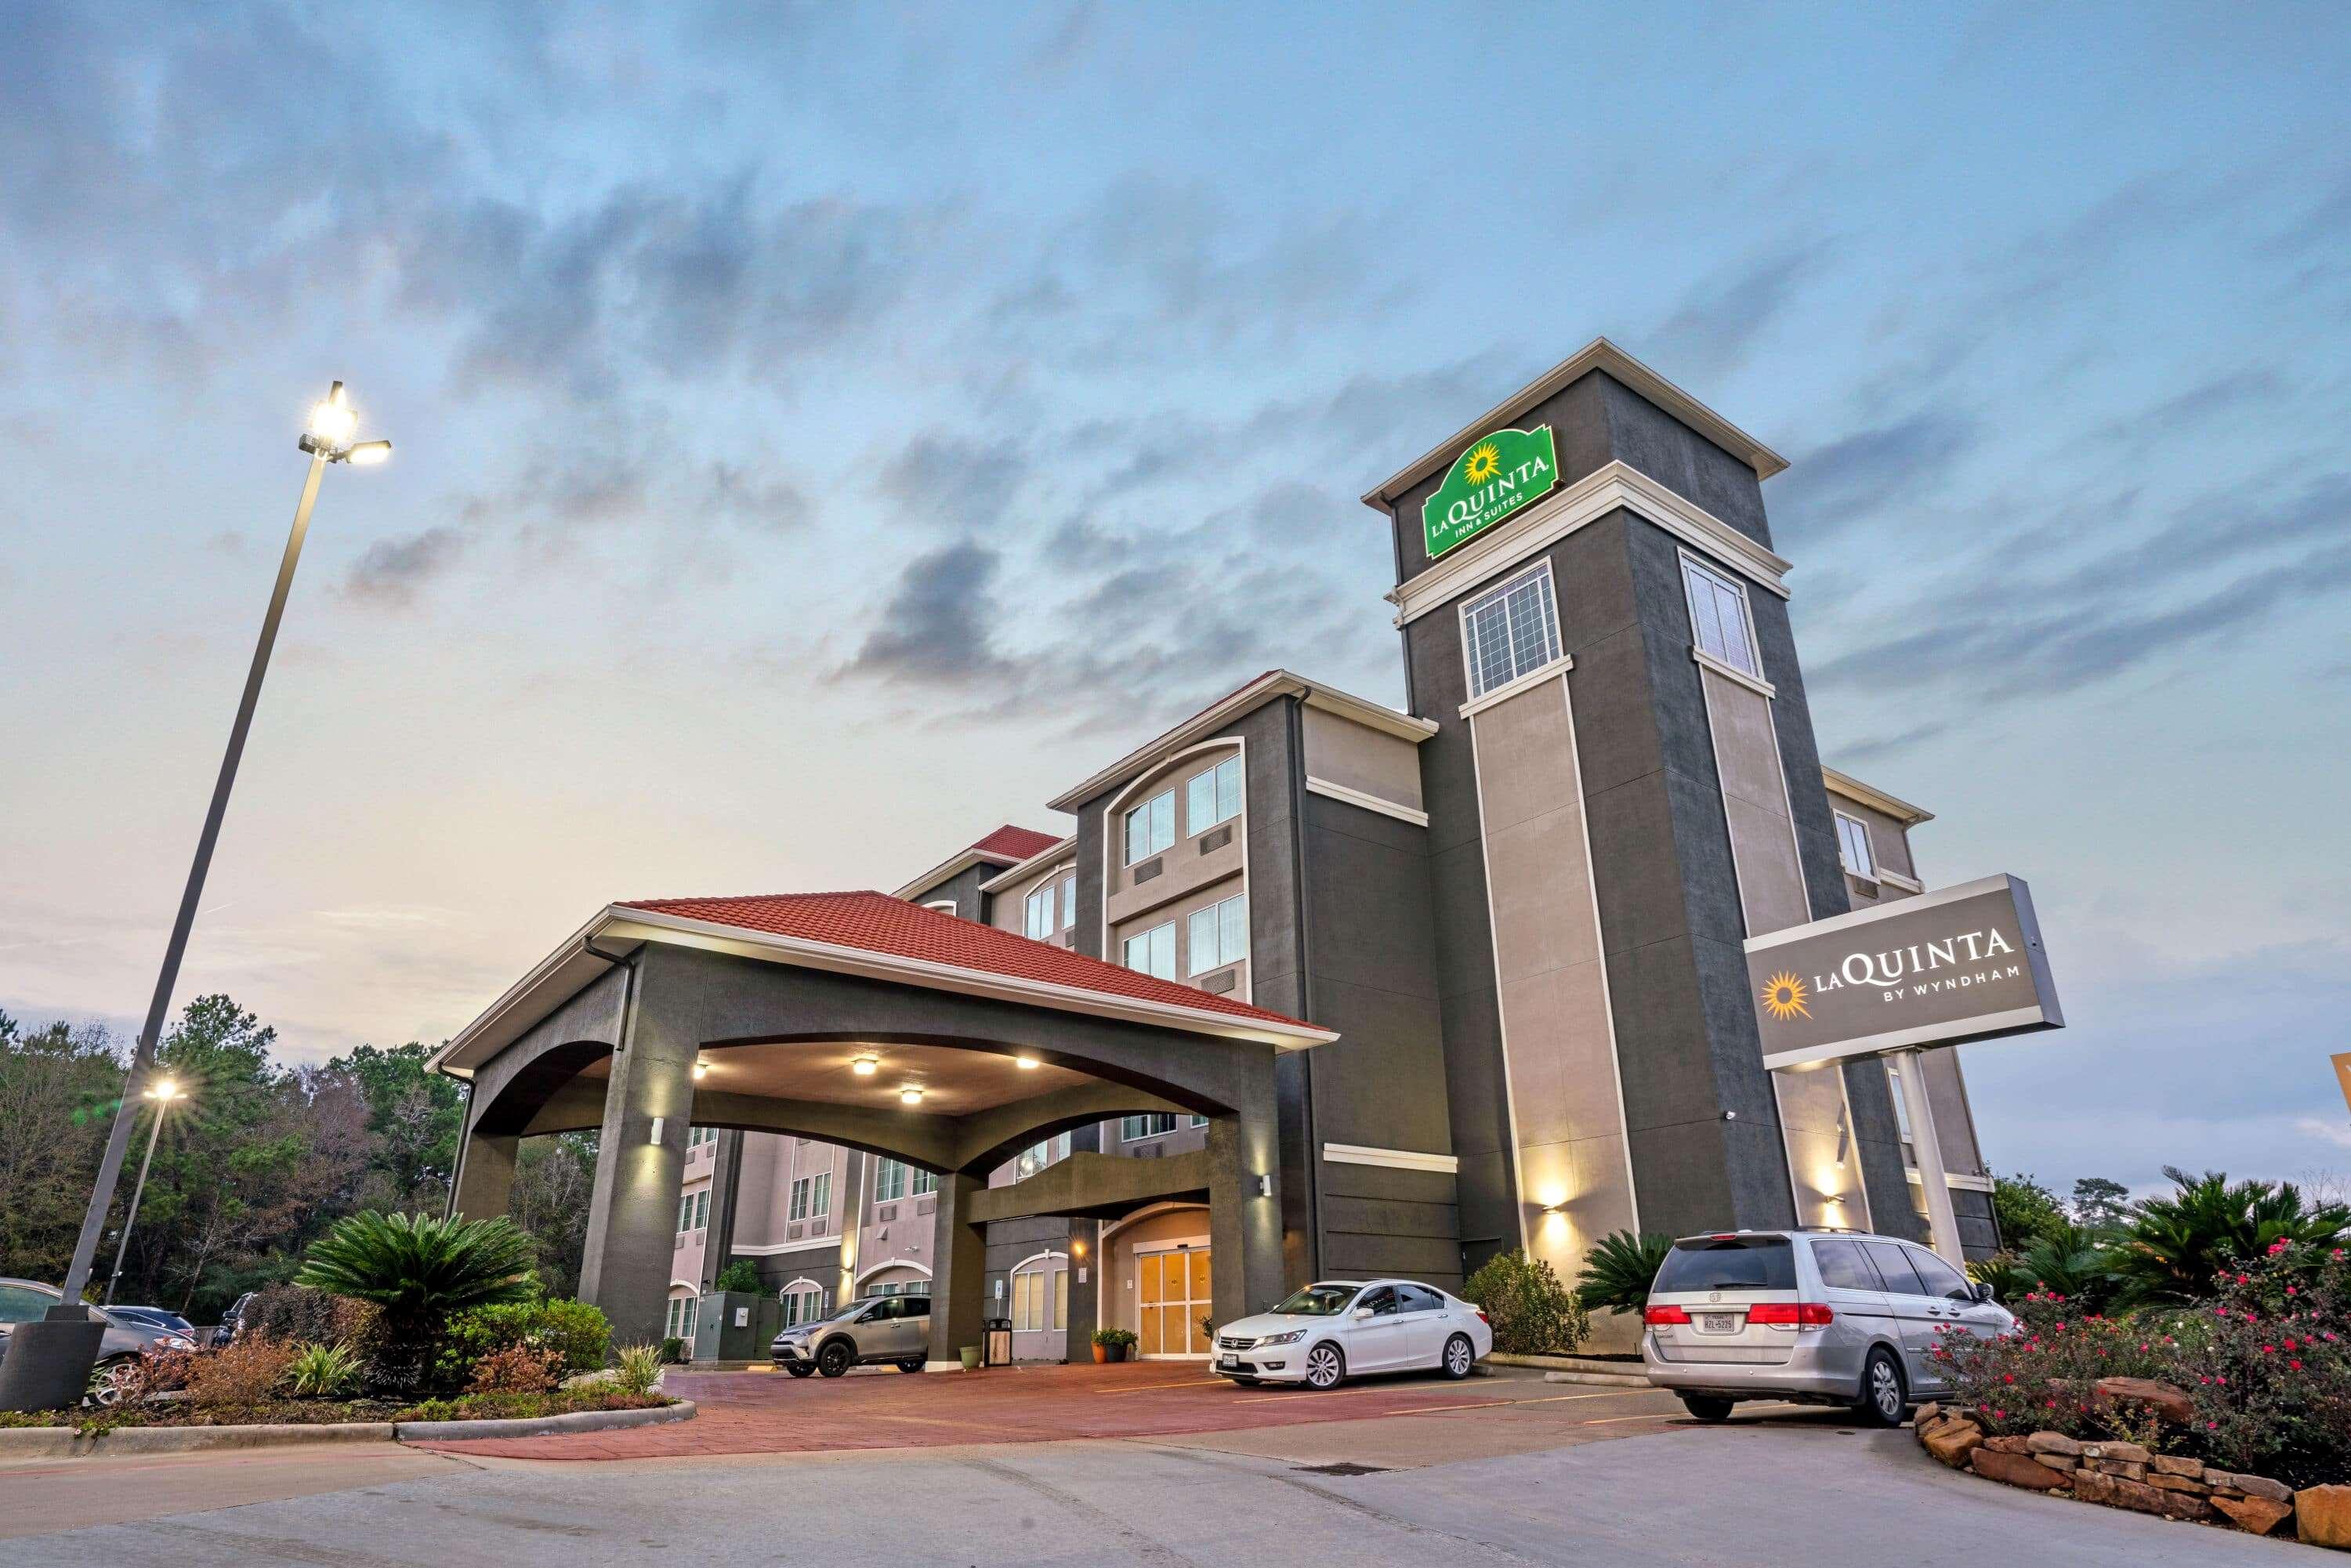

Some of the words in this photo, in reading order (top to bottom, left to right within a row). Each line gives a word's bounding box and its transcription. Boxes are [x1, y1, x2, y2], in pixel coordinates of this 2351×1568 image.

[1432, 520, 1449, 538] LA
[1448, 456, 1549, 525] QUINTA
[1455, 521, 1473, 538] INN
[1476, 518, 1483, 527] &
[1484, 492, 1523, 521] SUITES
[1813, 972, 1844, 993] LA
[1842, 928, 2015, 987] QUINTA
[1884, 988, 1905, 1002] BY
[1914, 965, 2020, 995] WYNDHAM
